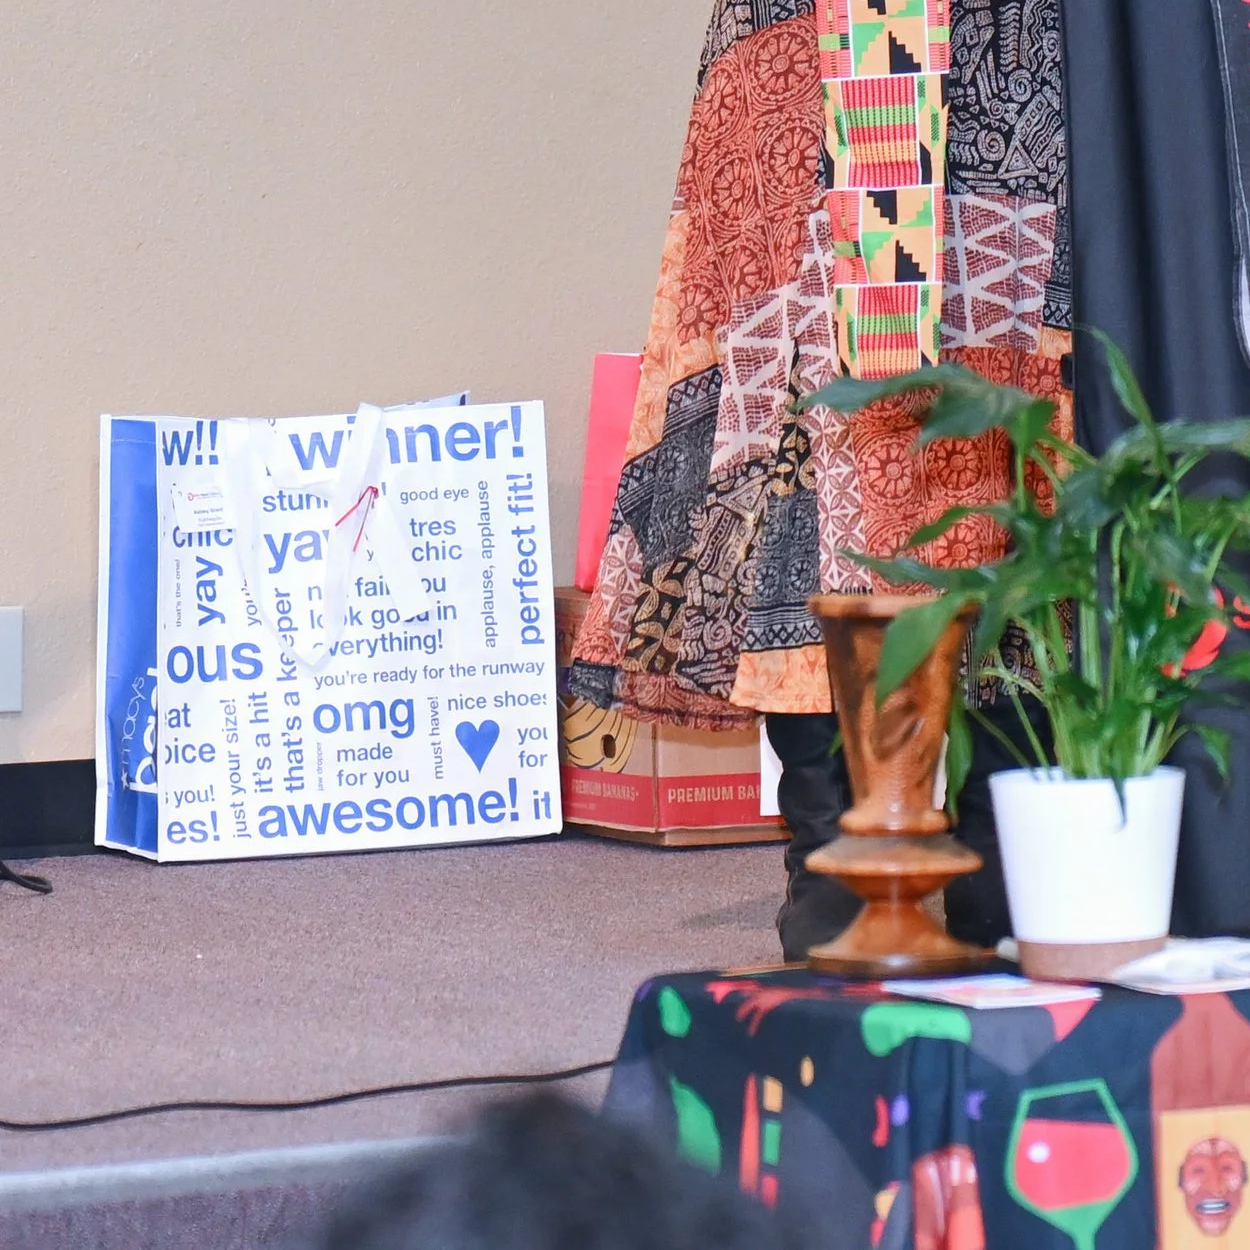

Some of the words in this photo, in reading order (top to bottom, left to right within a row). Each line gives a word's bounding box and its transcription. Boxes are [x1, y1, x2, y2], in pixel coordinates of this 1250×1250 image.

[400, 487, 438, 505] good
[443, 488, 470, 503] eye
[506, 473, 534, 515] fit!
[409, 518, 457, 537] tres
[477, 480, 495, 559] applause
[411, 540, 463, 562] chic
[196, 555, 226, 627] yay
[511, 524, 545, 645] perfect
[436, 600, 457, 621] in
[480, 565, 498, 648] applause,
[312, 628, 444, 658] verything!
[166, 642, 264, 684] ous
[314, 670, 368, 690] you're
[373, 666, 417, 684] ready
[422, 664, 445, 680] for
[449, 663, 477, 678] the
[482, 661, 545, 676] runway
[248, 691, 270, 724] hit
[284, 691, 301, 707] a
[427, 696, 440, 737] have!
[447, 693, 487, 711] nice
[219, 698, 239, 744] size!
[313, 698, 415, 739] omg
[255, 733, 271, 748] a
[281, 715, 305, 794] that's
[336, 742, 394, 762] made
[227, 750, 247, 796] your
[252, 756, 273, 793] it's
[431, 740, 444, 780] must
[518, 750, 548, 768] for
[173, 784, 216, 809] you!
[336, 769, 368, 787] for
[374, 769, 410, 789] you
[668, 786, 734, 804] PREMIUM
[230, 801, 252, 839] just
[258, 777, 519, 840] awesome!
